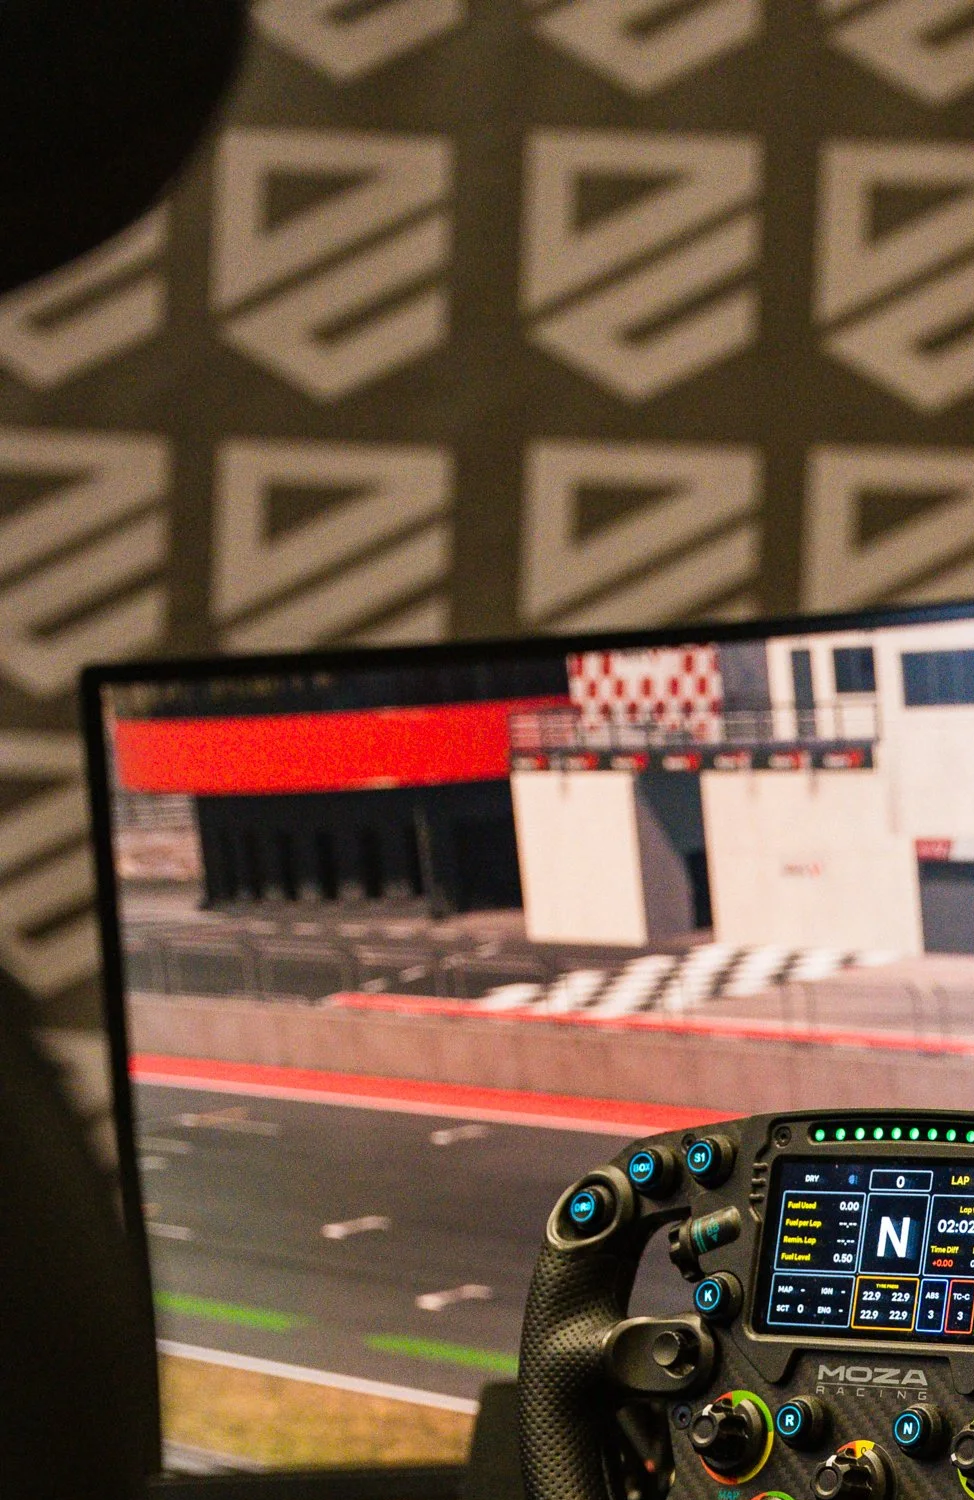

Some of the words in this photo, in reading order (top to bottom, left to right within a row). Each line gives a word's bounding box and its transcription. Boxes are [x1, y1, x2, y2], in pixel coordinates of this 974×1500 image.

[694, 1152, 705, 1163] S1
[633, 1164, 650, 1173] BOX
[805, 1174, 820, 1182] DRY
[896, 1175, 905, 1189] 0
[951, 1176, 970, 1185] LAP
[788, 1201, 801, 1209] Fuel
[801, 1201, 817, 1210] Used
[839, 1201, 860, 1211] 0.00
[960, 1206, 973, 1215] Lap
[785, 1218, 798, 1226] Fuel
[798, 1220, 809, 1228] per
[809, 1219, 822, 1228] Lap
[804, 1237, 817, 1245] Lap
[876, 1216, 911, 1258] N
[946, 1246, 959, 1254] Diff
[795, 1253, 811, 1261] Level
[833, 1253, 853, 1263] 0.50
[932, 1259, 953, 1267] +0.00
[778, 1285, 793, 1293] MAP
[704, 1290, 712, 1302] K
[862, 1291, 881, 1301] 22.9
[891, 1292, 910, 1302] 22.9
[797, 1304, 804, 1313] 0
[817, 1306, 831, 1314] ENG
[860, 1310, 879, 1320] 22.9
[889, 1311, 908, 1320] 22.9
[927, 1310, 934, 1319] 3
[957, 1311, 963, 1320] 3
[817, 1365, 928, 1386] MOZA
[815, 1385, 928, 1400] RACING
[785, 1415, 794, 1426] R
[903, 1423, 913, 1435] N
[718, 1491, 740, 1500] MAP
